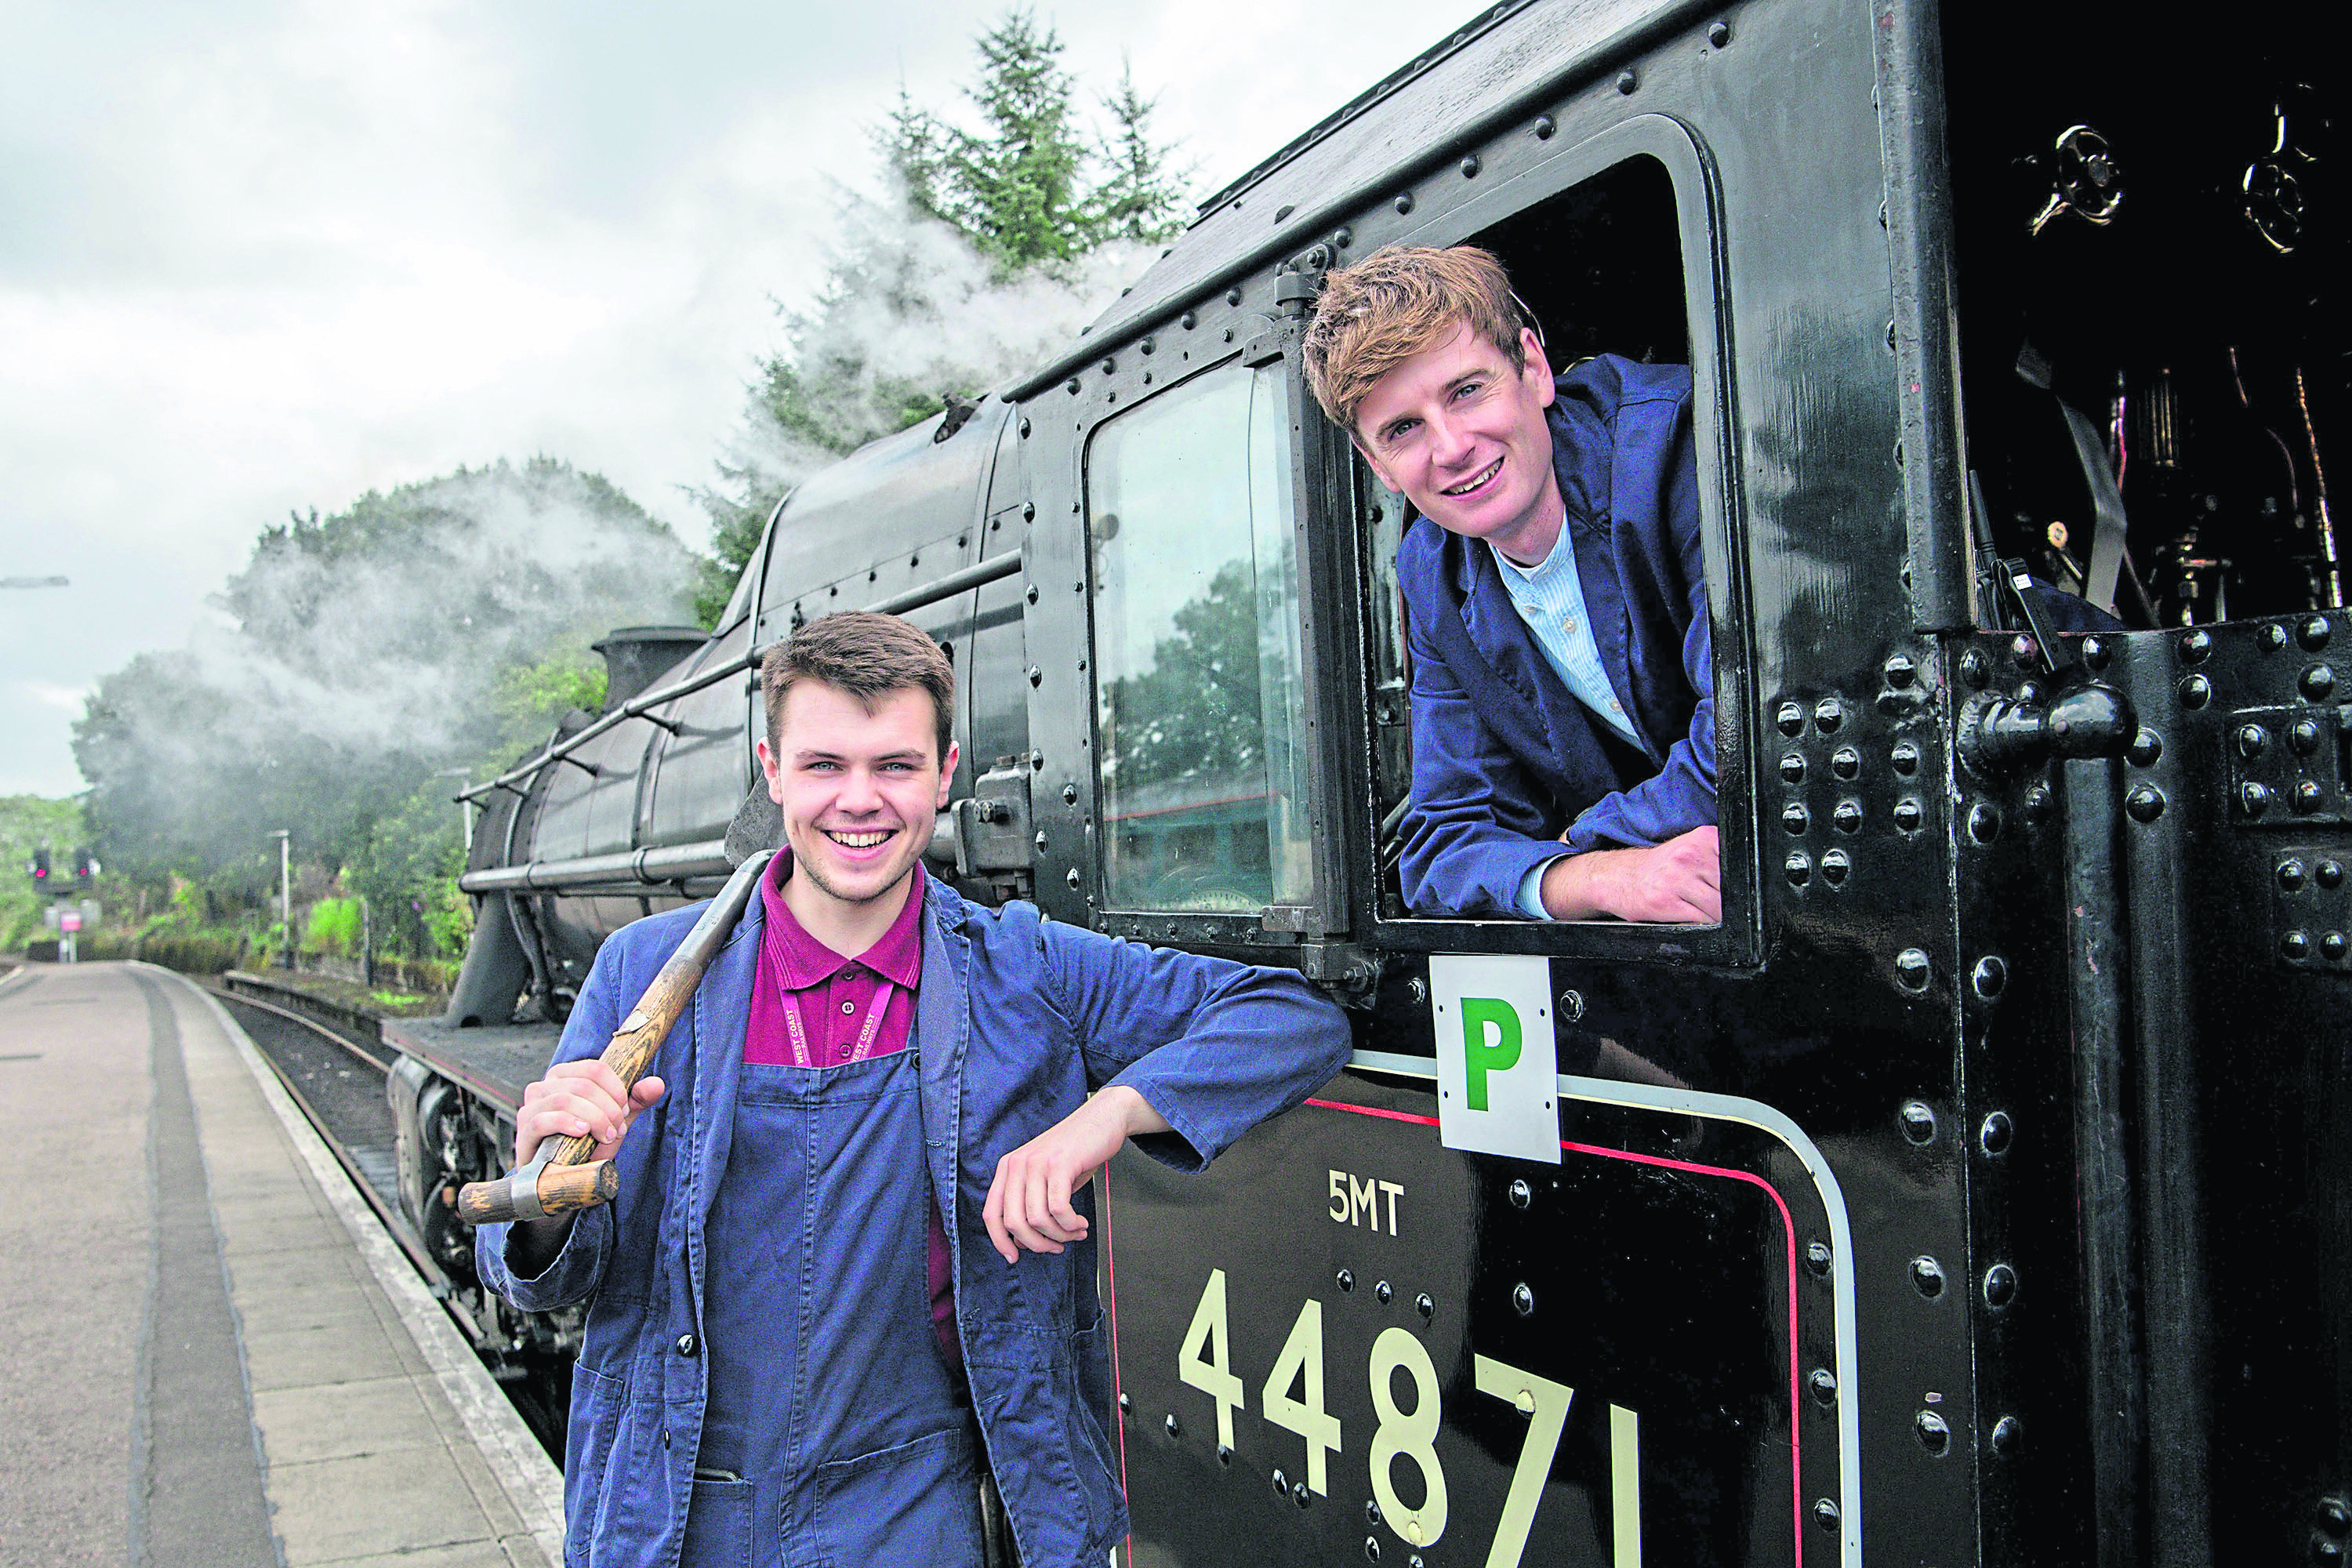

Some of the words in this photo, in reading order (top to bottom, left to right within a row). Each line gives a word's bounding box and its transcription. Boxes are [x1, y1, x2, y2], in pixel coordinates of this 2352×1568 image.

[786, 1010, 798, 1037] COAST
[797, 1022, 806, 1048] RAILWAYS
[860, 1013, 874, 1041] COAST
[793, 1040, 804, 1064] WEST
[862, 1029, 874, 1055] RAILWAYS
[1460, 997, 1523, 1112] P
[1329, 1169, 1404, 1236] 5MT
[1179, 1268, 1642, 1568] 44871
